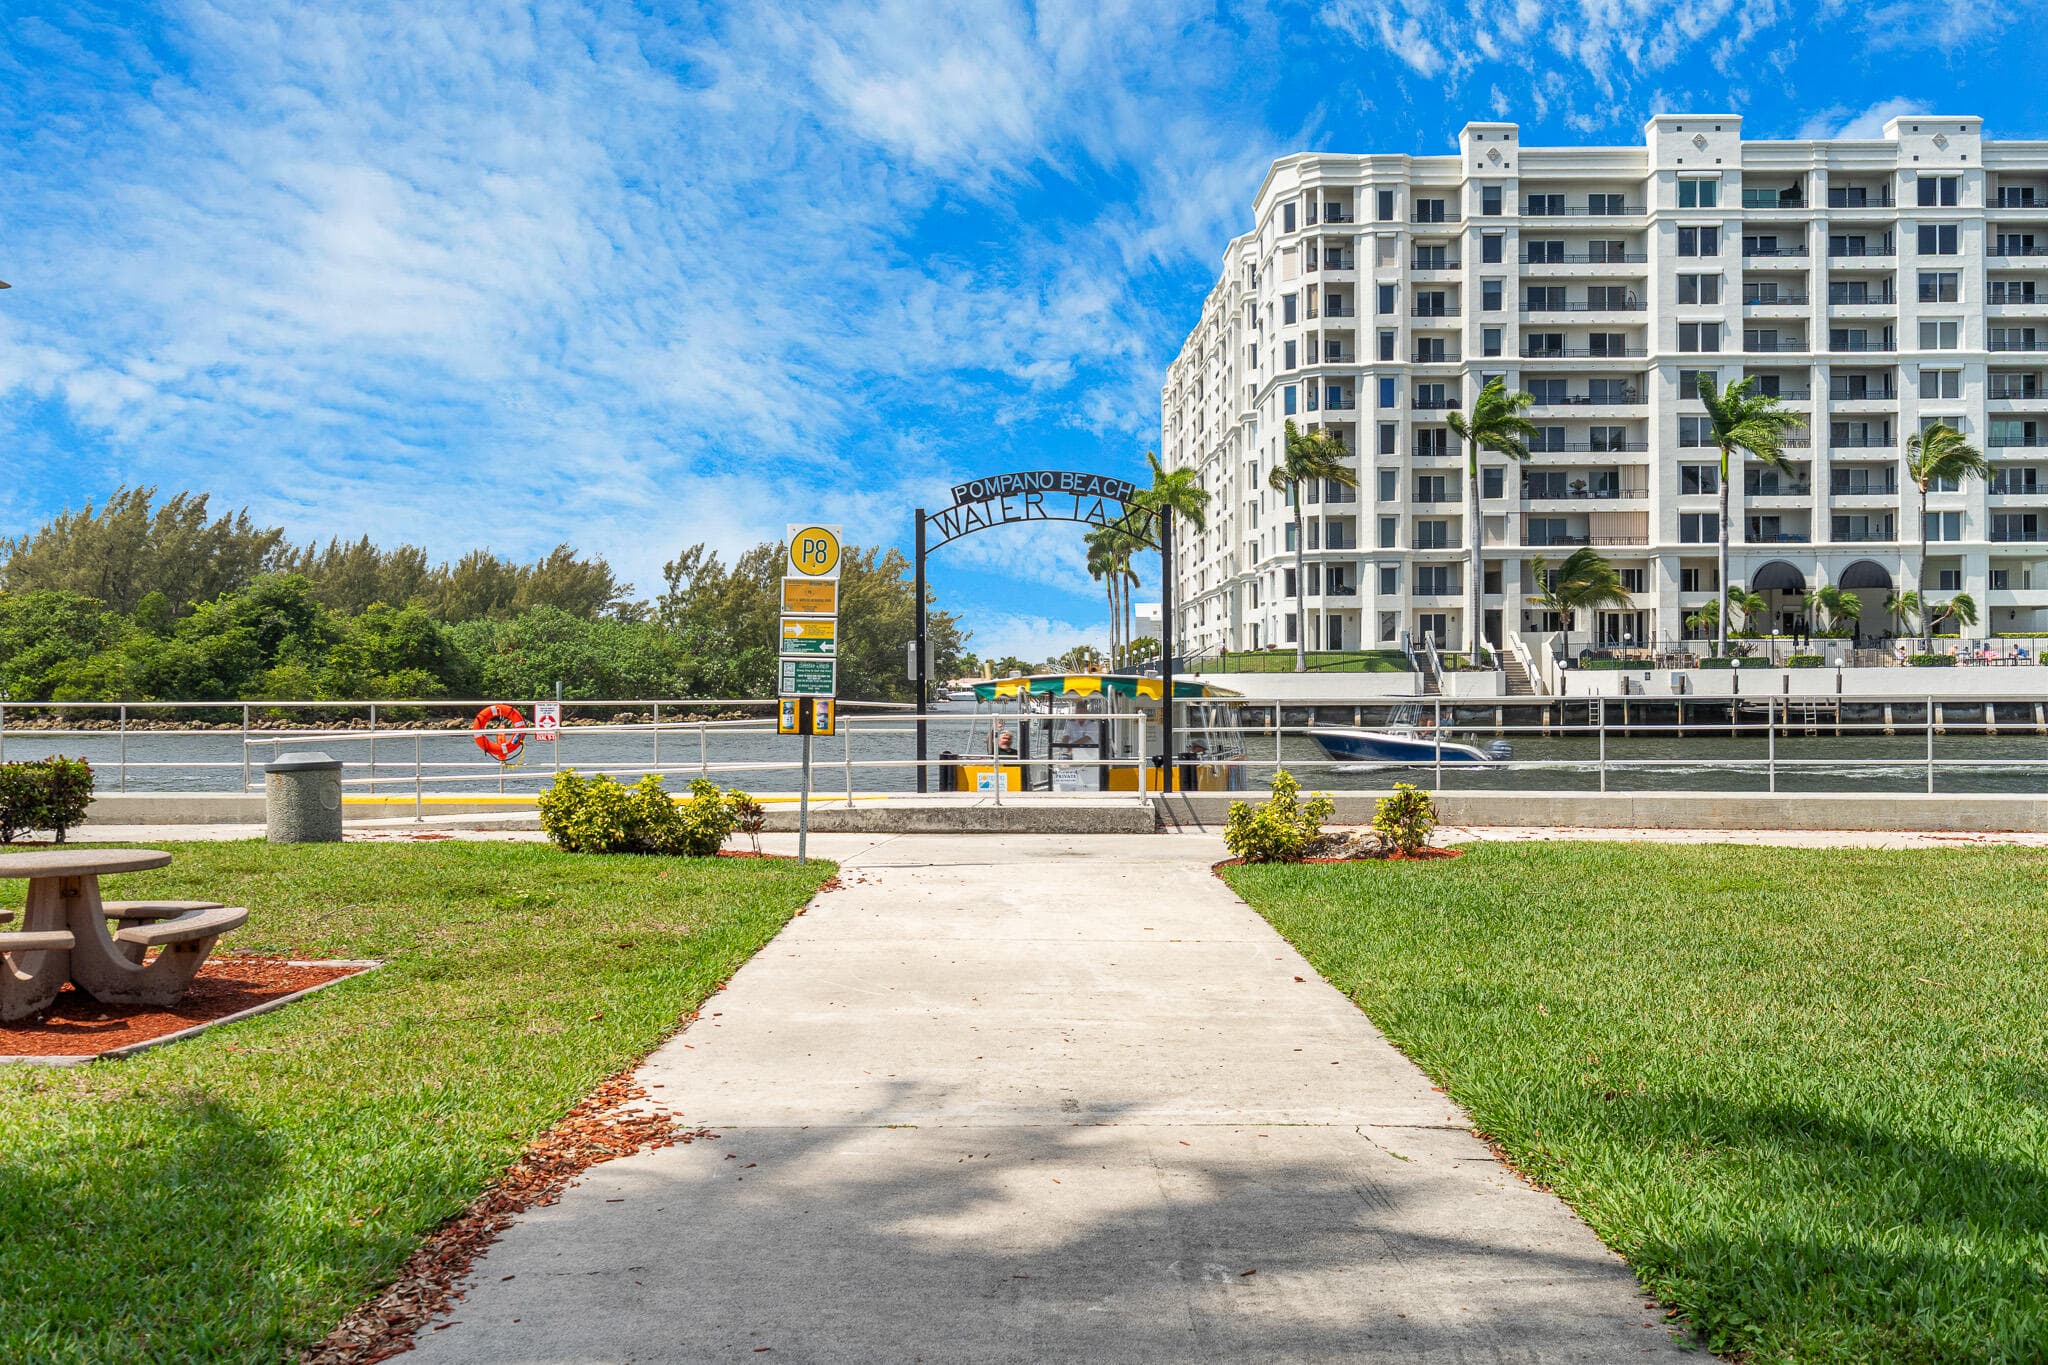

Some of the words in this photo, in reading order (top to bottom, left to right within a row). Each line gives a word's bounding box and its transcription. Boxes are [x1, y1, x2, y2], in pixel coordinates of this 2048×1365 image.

[954, 472, 1054, 504] POMPANO
[1060, 472, 1133, 501] BEACH
[932, 491, 1048, 540] WATER
[1068, 491, 1154, 539] TAXI
[802, 538, 828, 564] P8
